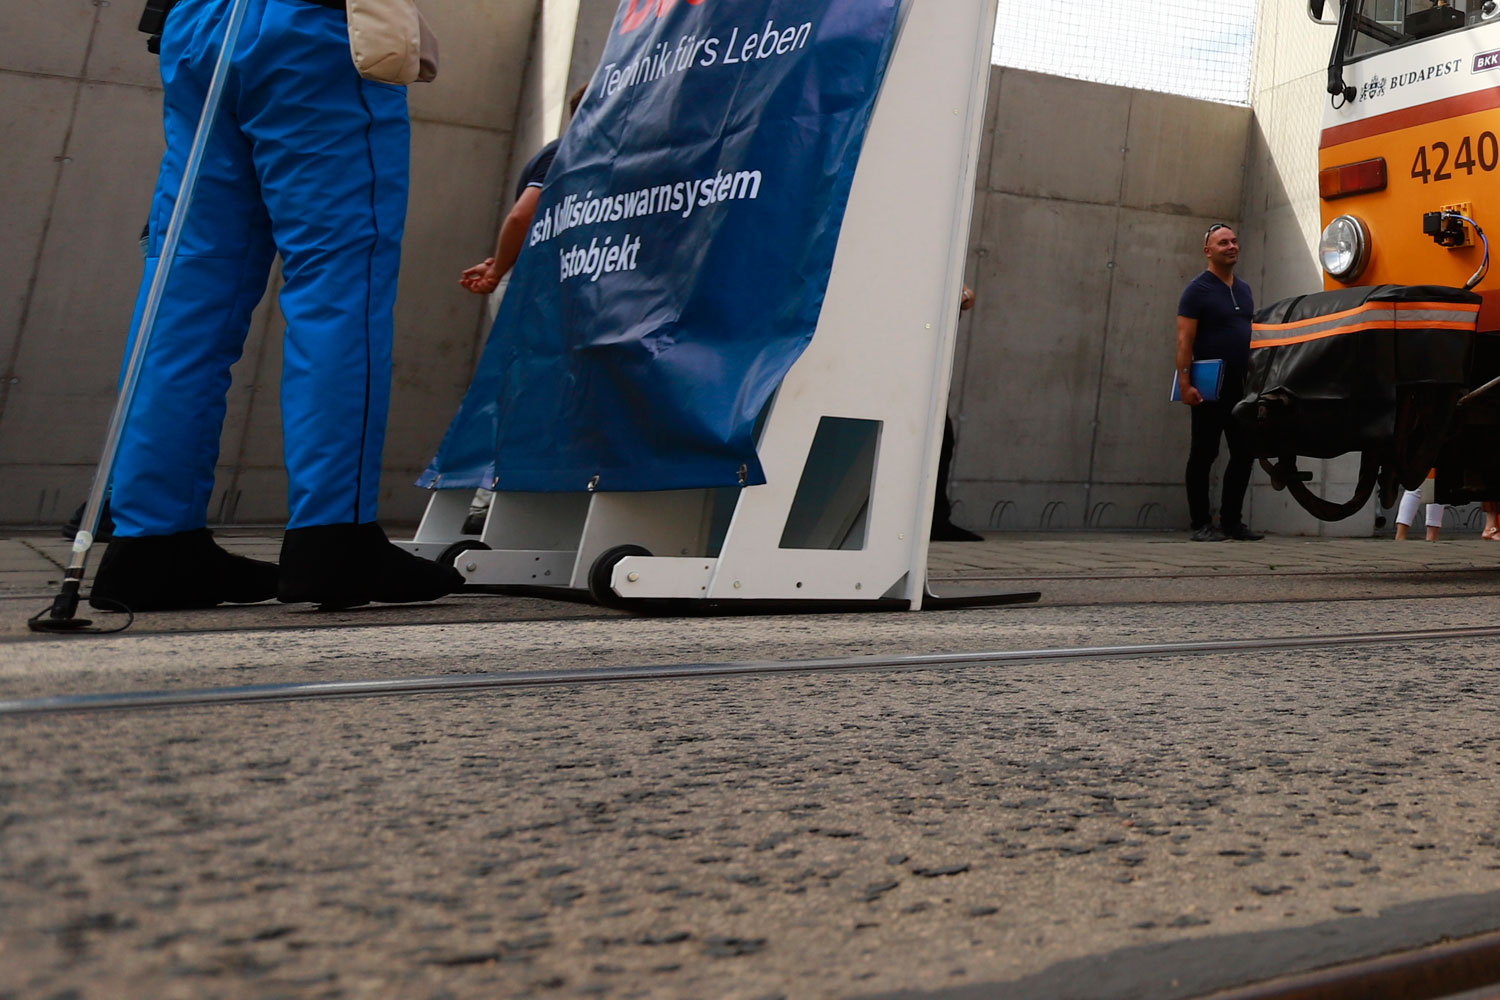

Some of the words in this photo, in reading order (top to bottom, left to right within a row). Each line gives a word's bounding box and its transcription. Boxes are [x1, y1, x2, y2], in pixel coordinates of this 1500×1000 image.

[599, 41, 673, 99] Technik
[671, 34, 718, 75] fürs
[723, 20, 812, 64] Leben
[1389, 58, 1463, 90] BUDAPEST
[1477, 54, 1499, 68] BKK
[1411, 131, 1499, 184] 4240
